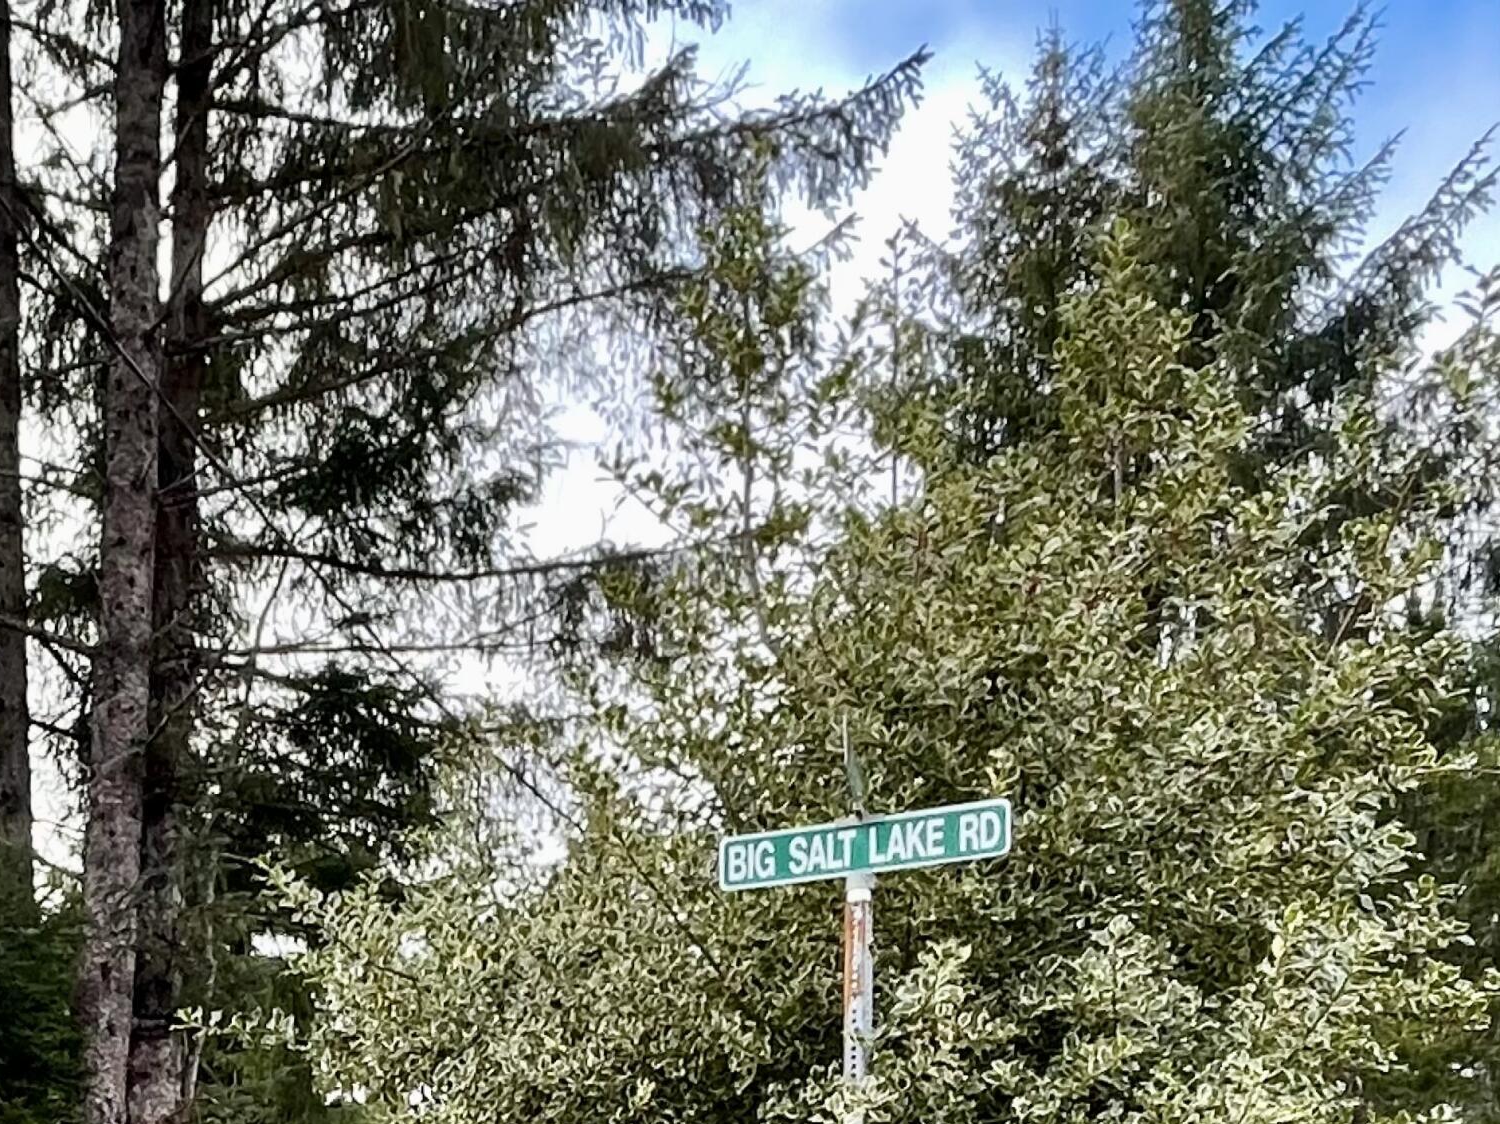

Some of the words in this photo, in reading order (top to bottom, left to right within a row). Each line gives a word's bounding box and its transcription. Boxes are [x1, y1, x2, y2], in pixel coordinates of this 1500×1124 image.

[728, 843, 775, 881] BIG
[788, 829, 856, 874] SALT
[868, 818, 945, 864] LAKE
[959, 811, 1000, 851] RD
